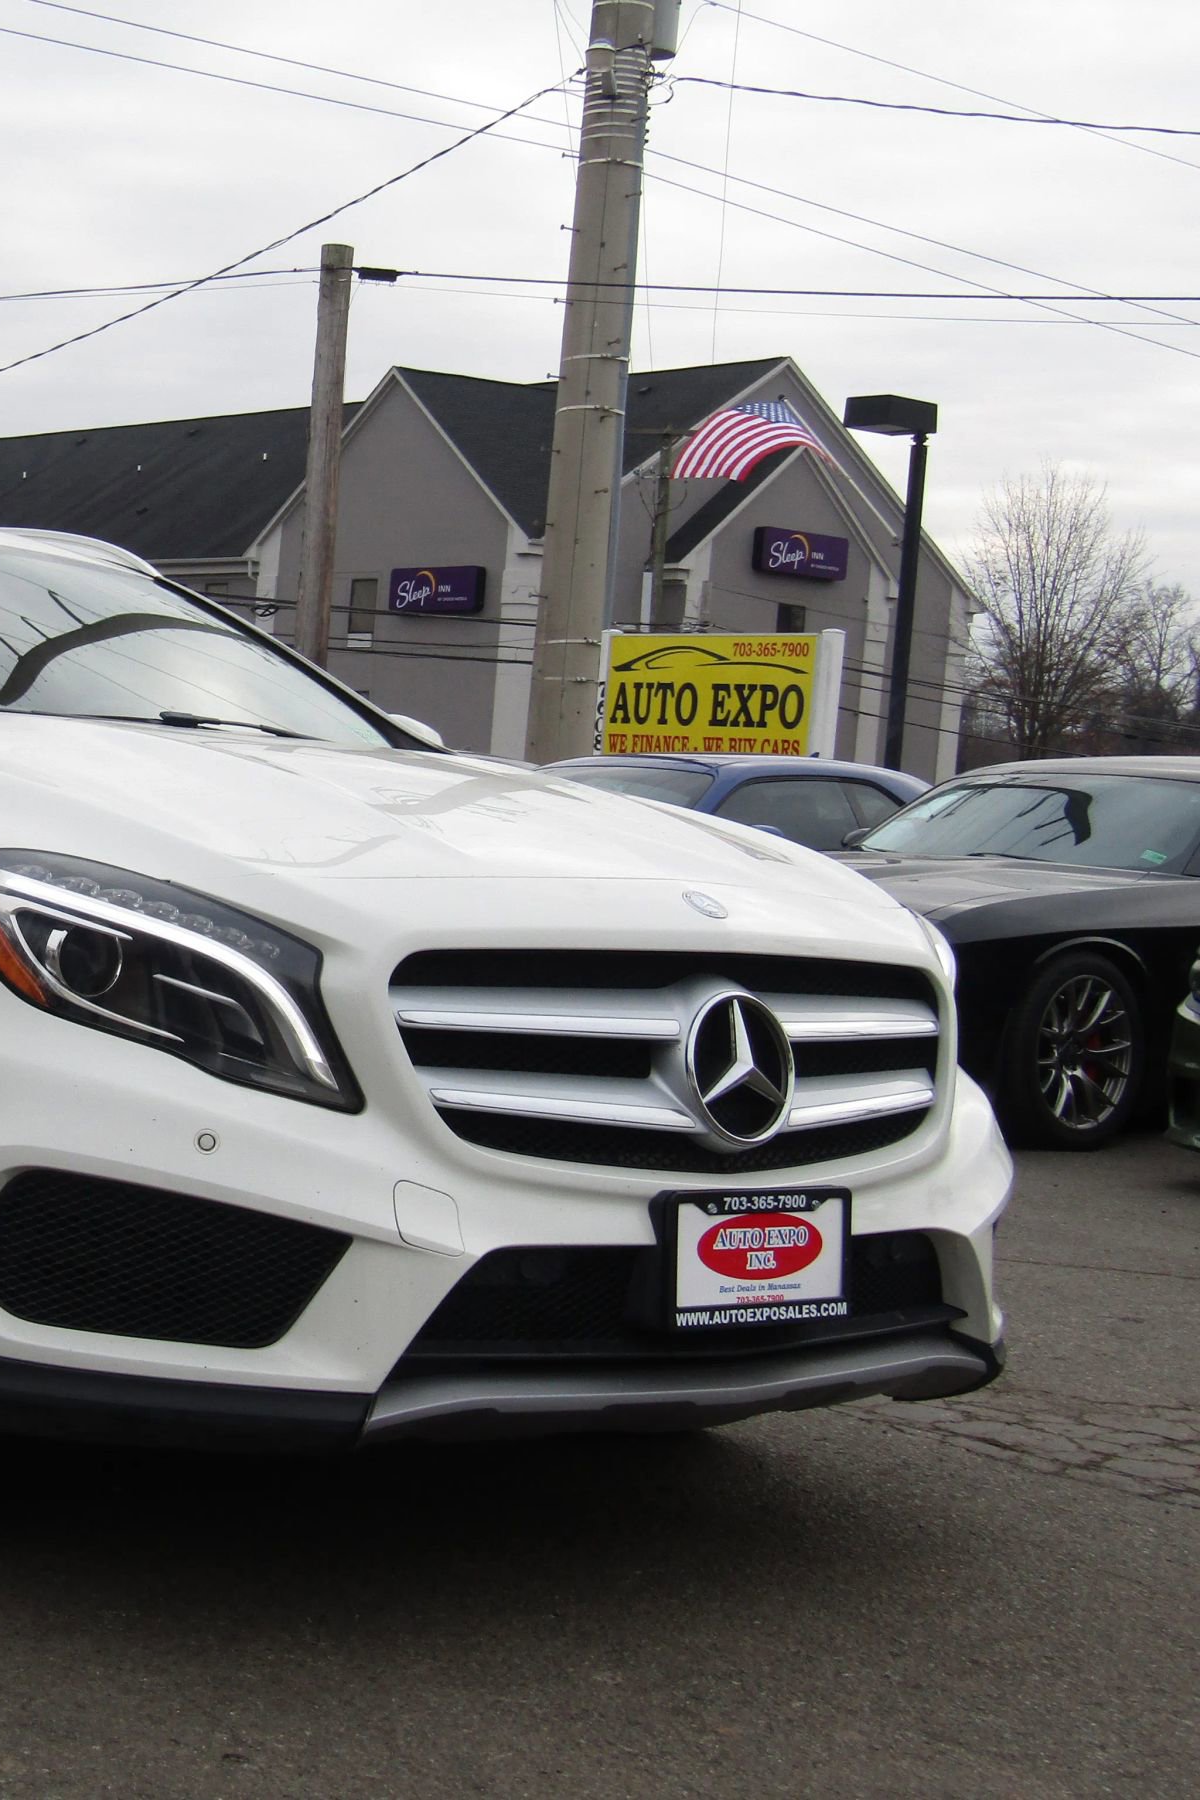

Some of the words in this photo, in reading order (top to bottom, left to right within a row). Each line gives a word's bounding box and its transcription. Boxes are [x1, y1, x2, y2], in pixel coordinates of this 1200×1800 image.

[769, 541, 805, 570] Sleep
[811, 551, 825, 561] INN
[396, 580, 432, 608] Sleep
[438, 584, 452, 593] INN
[732, 642, 809, 658] 703-365-7900
[609, 681, 699, 726] AUTO
[708, 683, 805, 730] EXPO
[608, 733, 628, 753] WE
[632, 734, 690, 753] FINANCE
[703, 736, 724, 753] WE
[728, 737, 758, 754] BUY
[762, 739, 801, 756] CARS
[723, 1194, 807, 1211] 703-365-7900
[713, 1228, 764, 1250] AUTO
[765, 1226, 809, 1248] EXPO
[746, 1251, 776, 1270] INC.
[719, 1285, 735, 1294] Best
[736, 1284, 756, 1293] Deals
[758, 1283, 766, 1291] in
[767, 1282, 801, 1291] Manassas
[736, 1294, 785, 1304] 703-365-7900
[676, 1302, 847, 1327] WWW.AUTOEXPOSALES.COM
